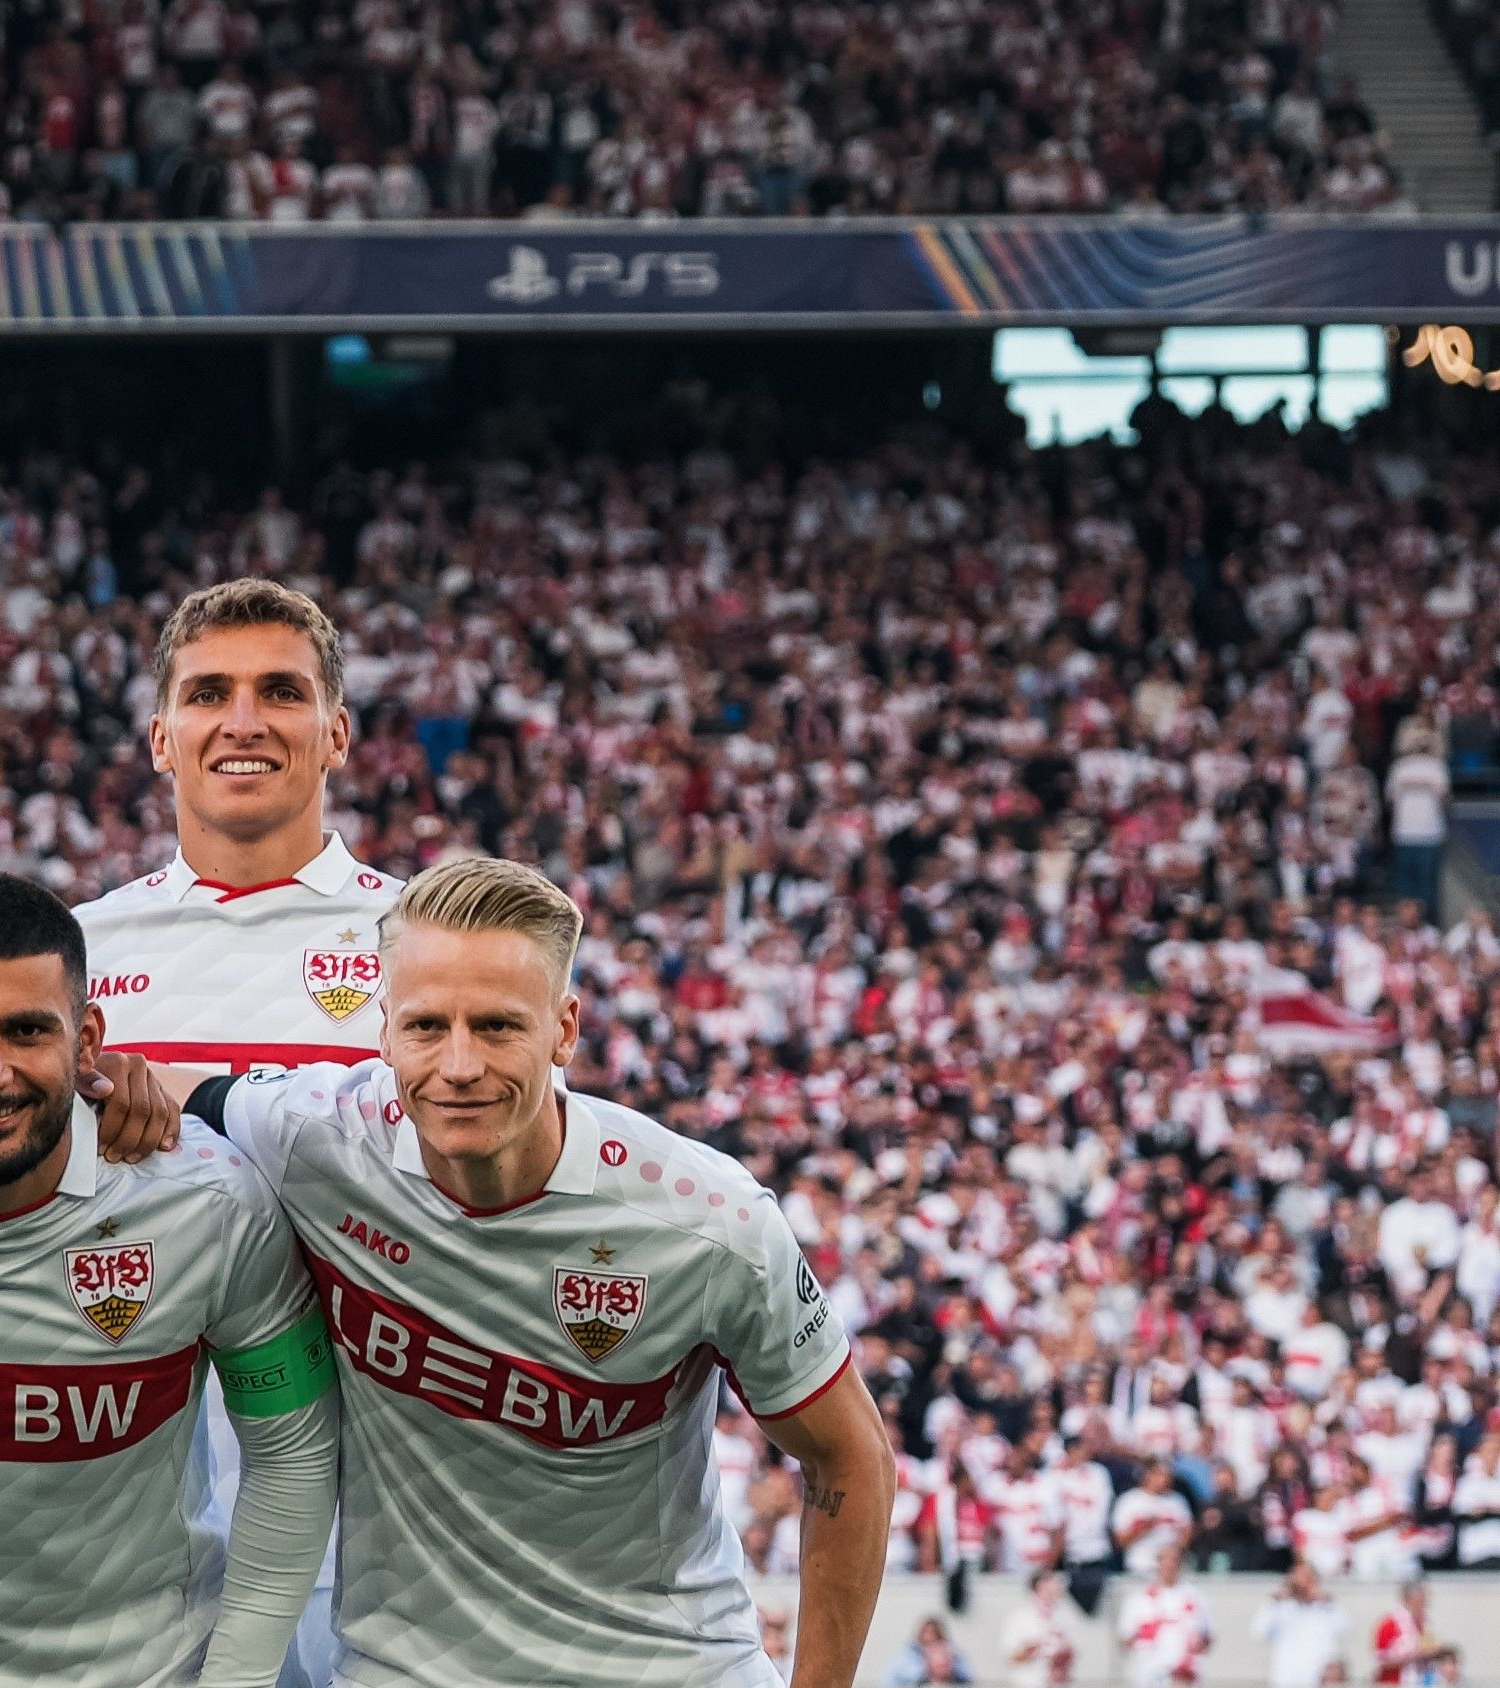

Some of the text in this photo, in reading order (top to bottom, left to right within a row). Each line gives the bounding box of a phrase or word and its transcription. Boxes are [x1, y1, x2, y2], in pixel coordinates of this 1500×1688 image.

[567, 251, 720, 297] PS5
[87, 973, 150, 1000] JAKO
[336, 1213, 411, 1265] JAKO
